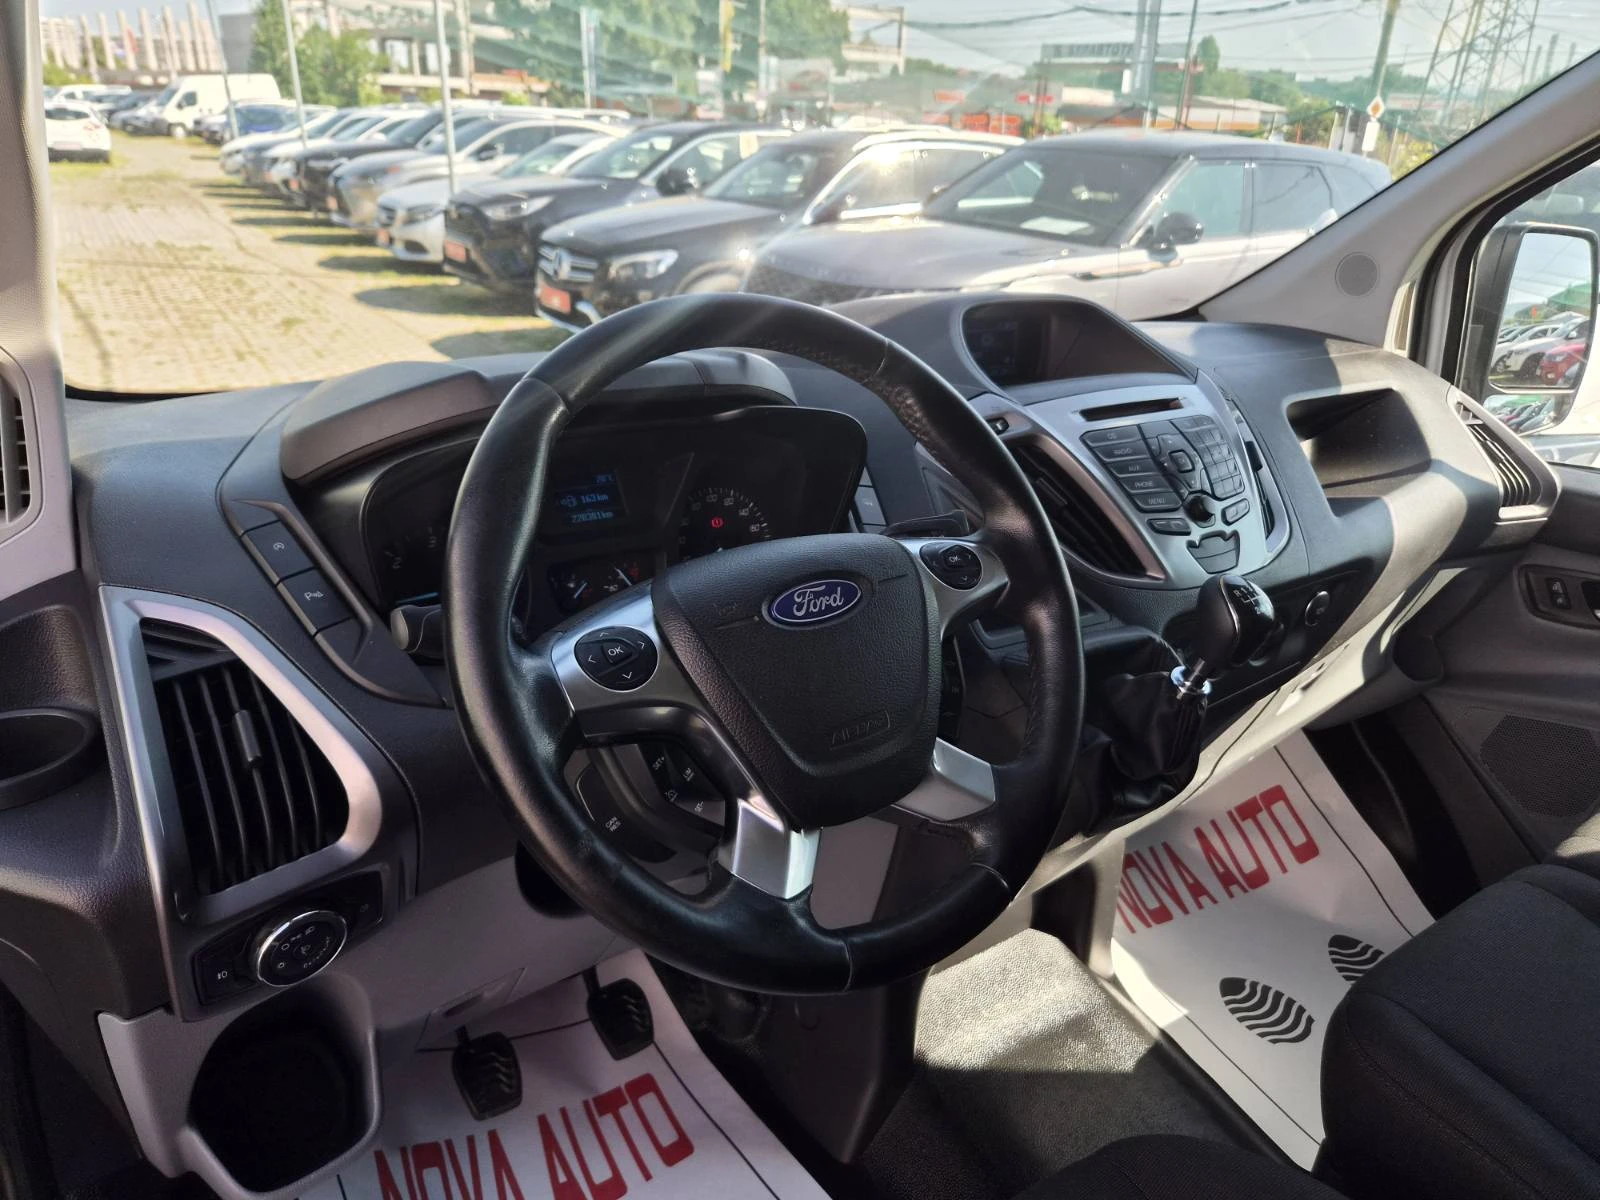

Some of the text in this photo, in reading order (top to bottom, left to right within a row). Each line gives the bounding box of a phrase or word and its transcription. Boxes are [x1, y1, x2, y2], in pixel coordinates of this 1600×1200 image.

[792, 584, 845, 617] Ford
[607, 646, 624, 656] OK
[1116, 784, 1319, 934] NOVA AUTO
[536, 1073, 694, 1200] AUTO
